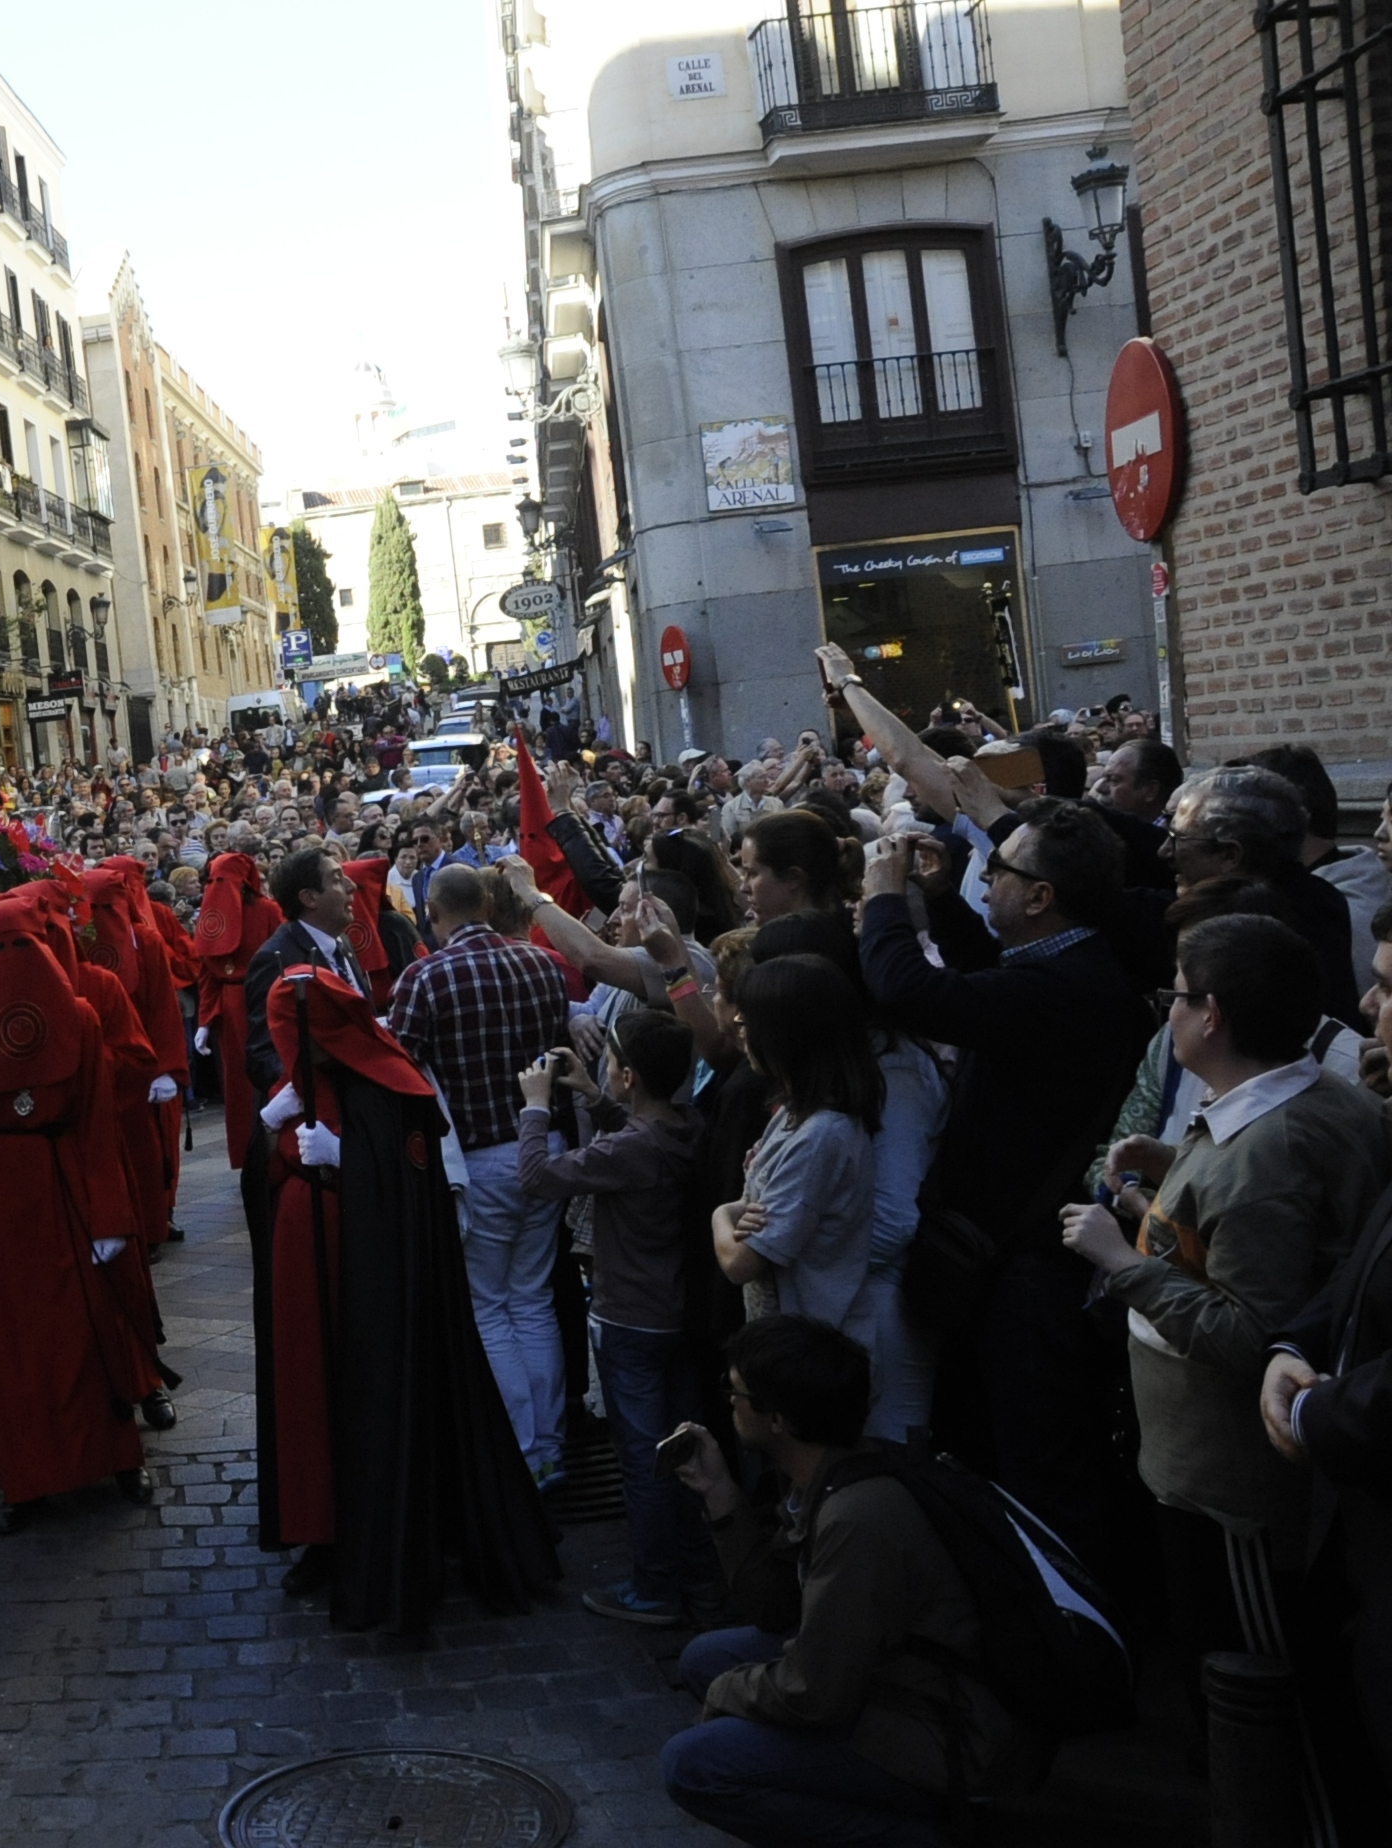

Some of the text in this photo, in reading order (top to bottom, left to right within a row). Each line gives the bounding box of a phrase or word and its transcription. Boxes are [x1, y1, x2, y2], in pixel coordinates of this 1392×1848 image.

[678, 58, 711, 72] CALLE
[688, 72, 703, 81] DEL
[679, 82, 715, 95] ARENAL
[715, 478, 760, 491] CALLE
[717, 487, 787, 507] ARENAL
[204, 479, 218, 535] GUERRERO
[864, 558, 903, 575] Cheeky
[907, 554, 943, 567] Cousin
[945, 550, 958, 565] of
[513, 593, 553, 611] 1902
[288, 633, 308, 651] P
[507, 667, 570, 691] RESTAURANTE
[28, 699, 65, 711] MESON
